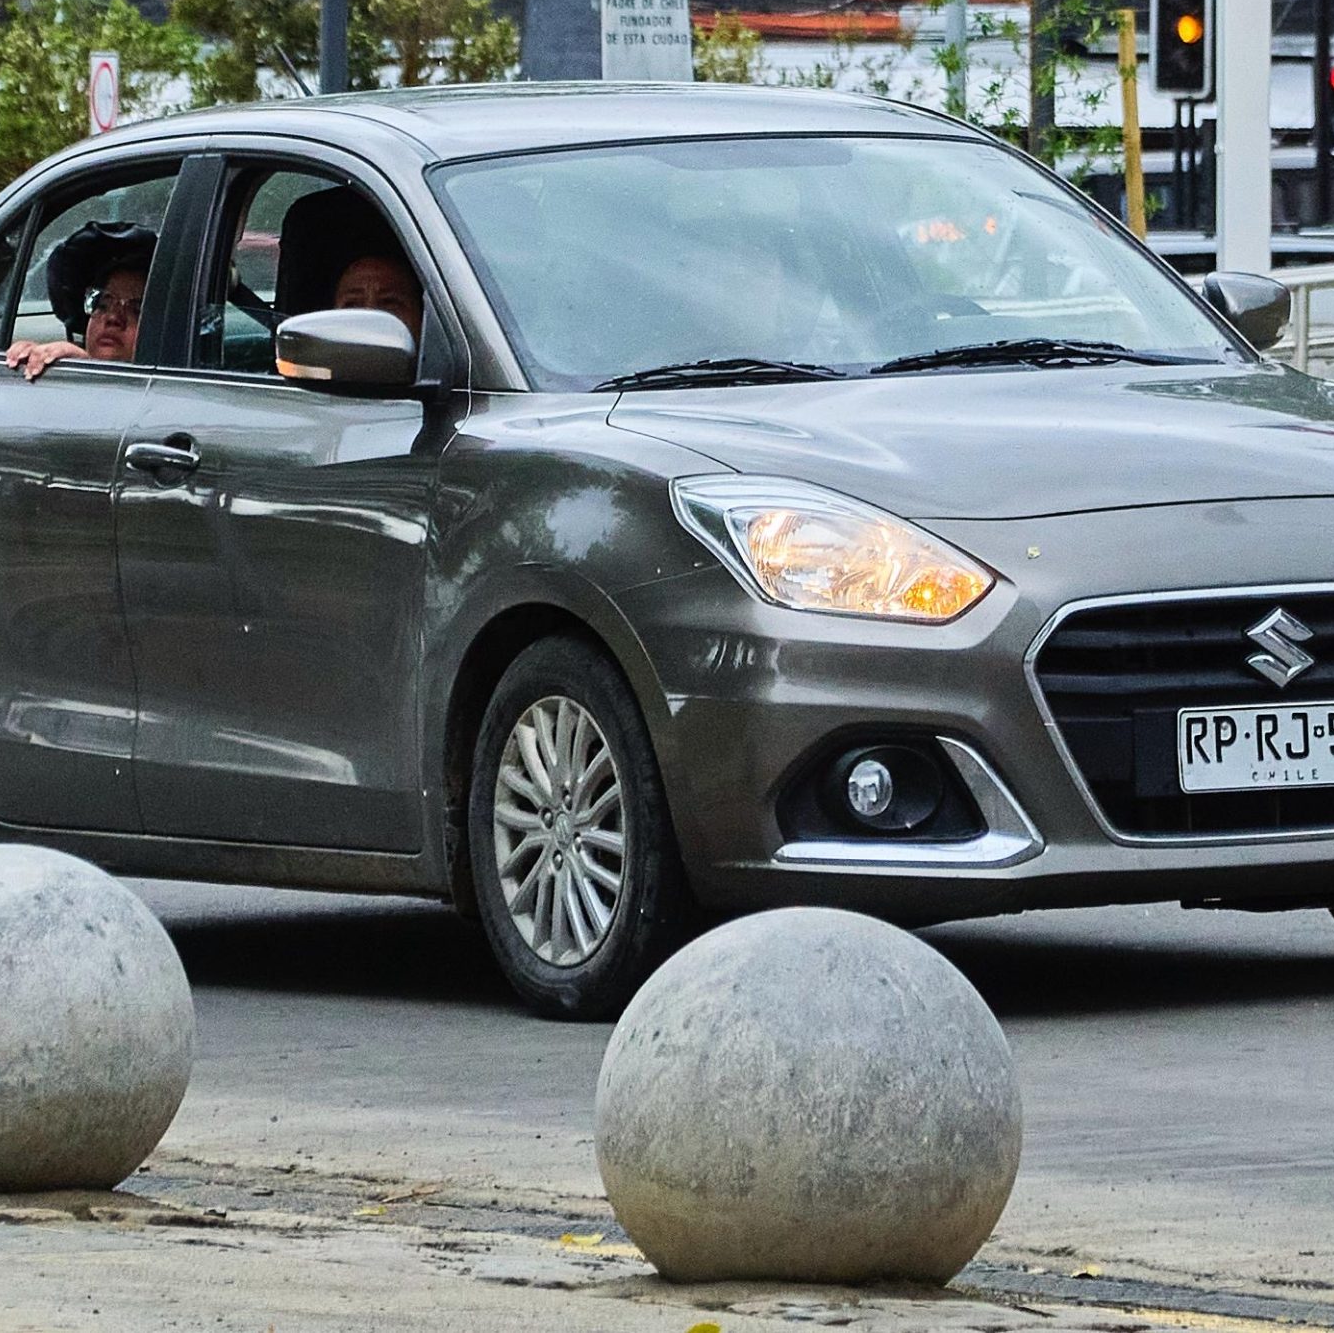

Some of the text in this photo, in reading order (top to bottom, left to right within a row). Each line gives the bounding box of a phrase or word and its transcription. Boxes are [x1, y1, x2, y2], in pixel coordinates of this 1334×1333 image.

[619, 15, 673, 27] FUNDADOR
[606, 34, 689, 45] DE ESTA CIUDAD
[1251, 768, 1320, 783] CHILE
